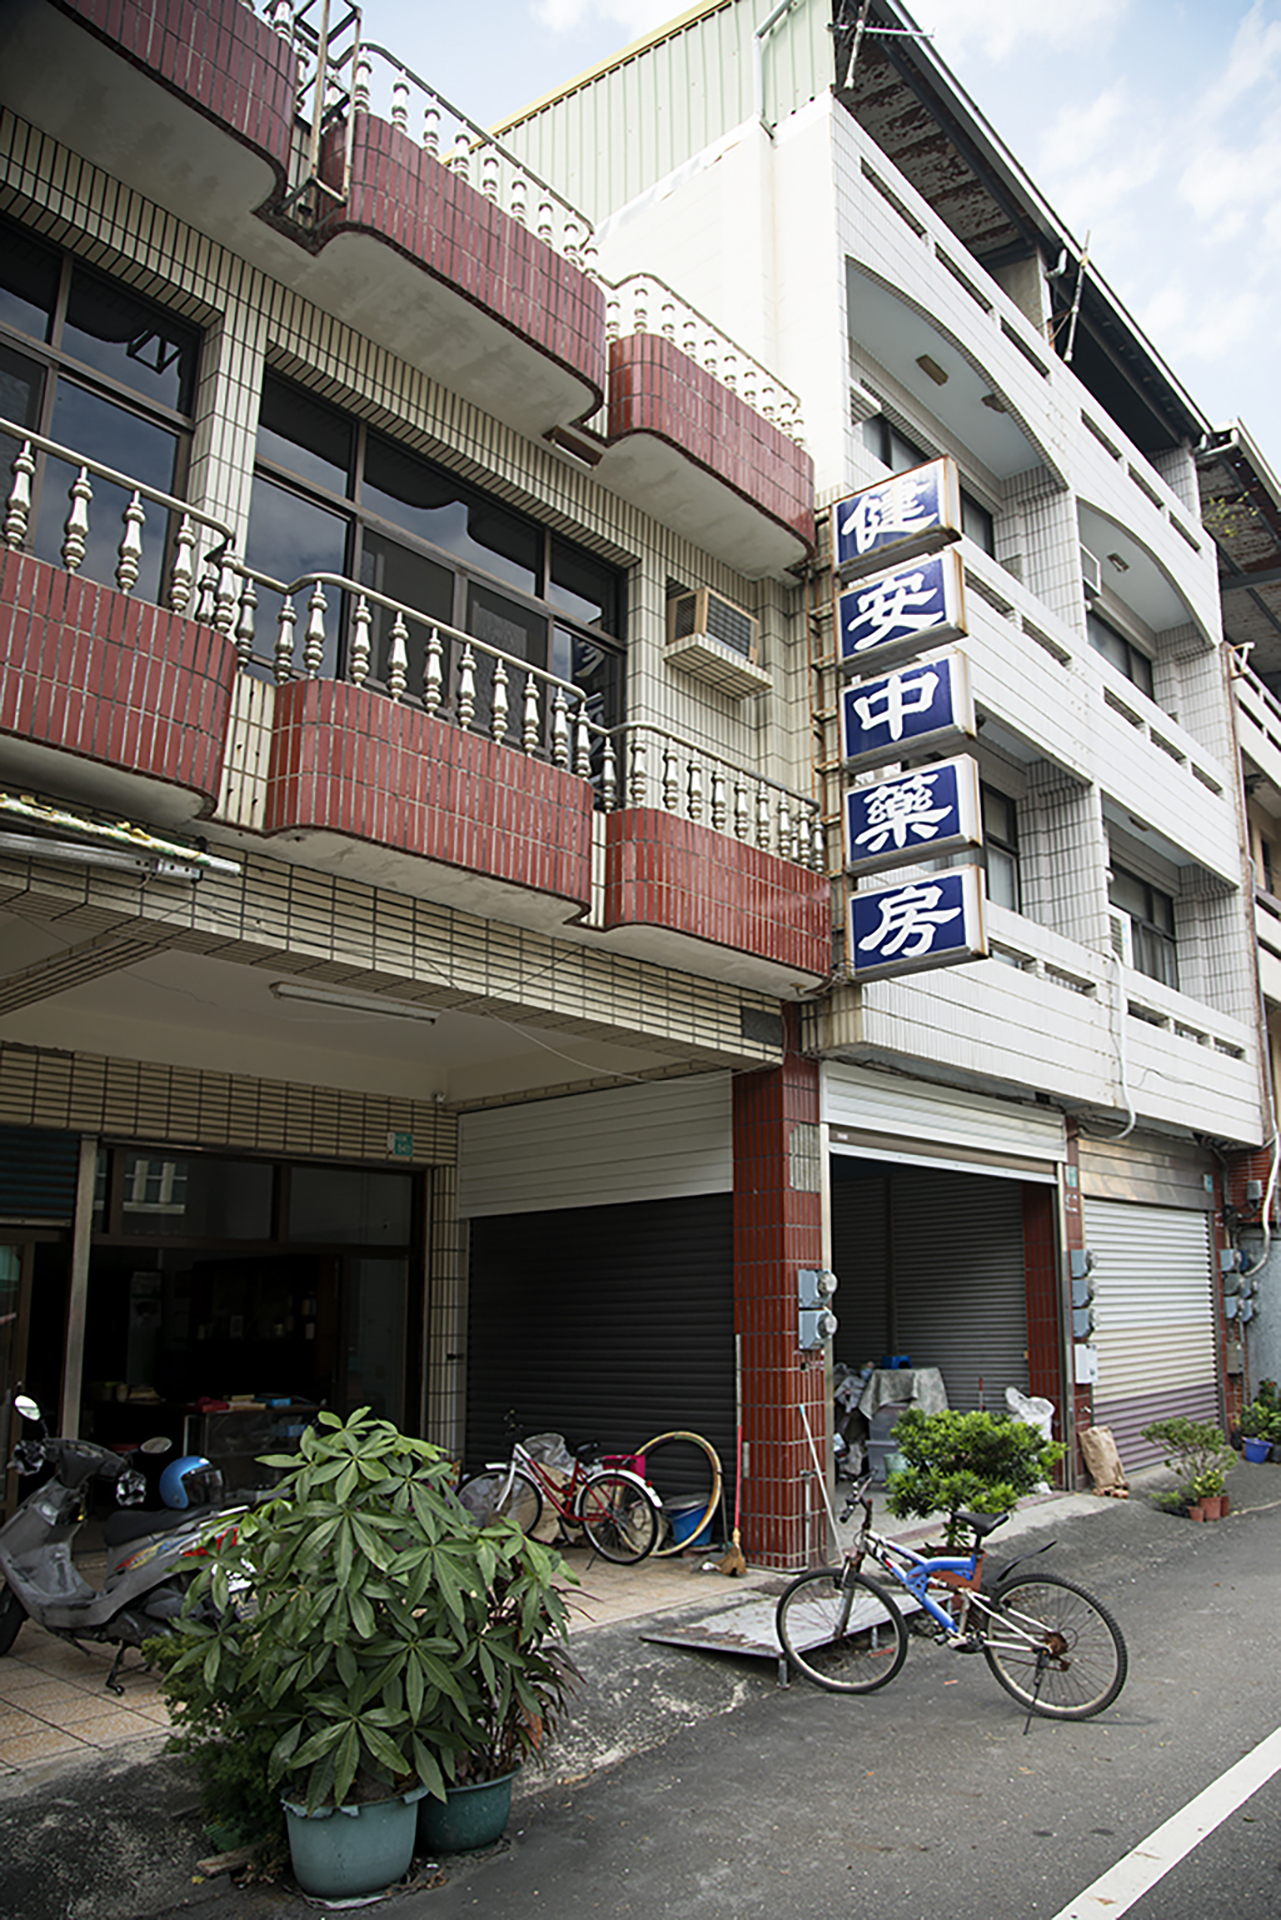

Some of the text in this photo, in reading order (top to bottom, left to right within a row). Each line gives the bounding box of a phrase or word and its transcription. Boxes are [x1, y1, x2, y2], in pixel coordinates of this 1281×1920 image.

[842, 480, 961, 957] 健安中藥房
